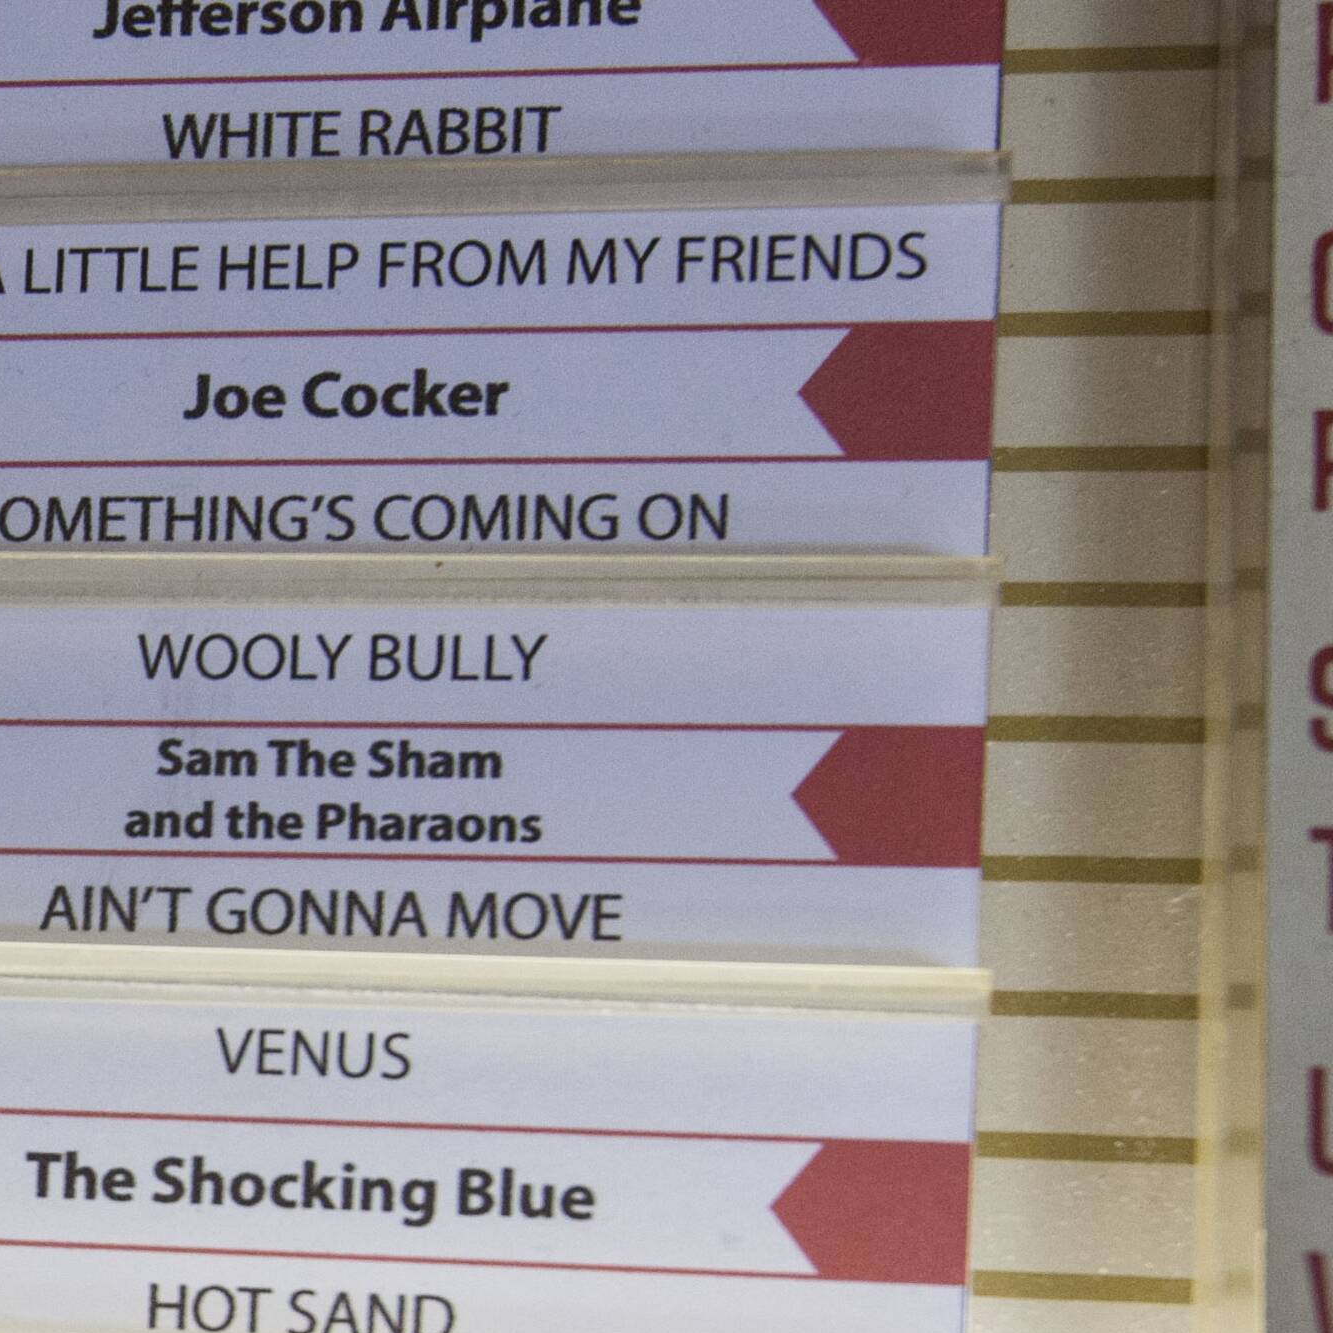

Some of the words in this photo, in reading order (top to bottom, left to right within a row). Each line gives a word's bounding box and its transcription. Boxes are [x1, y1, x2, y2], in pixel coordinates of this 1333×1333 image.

[93, 0, 363, 39] Jefferson
[381, 0, 641, 43] Airplane
[163, 111, 340, 160] WHITE
[359, 106, 561, 157] RABBIT
[24, 245, 199, 294] LITTLE
[218, 242, 360, 291] HELP
[379, 239, 546, 288] FROM
[567, 237, 660, 285] MY
[677, 231, 927, 283] FRIENDS
[183, 373, 286, 420] Joe
[302, 368, 509, 418] Cocker
[374, 493, 619, 542] COMING
[638, 493, 728, 541] ON
[138, 633, 352, 681] WOOLY
[369, 633, 547, 682] BULLY
[157, 738, 258, 777] Sam
[268, 738, 356, 778] The
[368, 739, 502, 779] Sham
[124, 803, 213, 840] and
[225, 804, 304, 841] the
[317, 805, 542, 844] Pharaons
[39, 885, 192, 934] AIN'T
[206, 887, 428, 938] GONNA
[447, 892, 622, 942] MOVE
[216, 1028, 411, 1081] VENUS
[26, 1151, 136, 1202] The
[153, 1155, 437, 1227] Shocking
[458, 1167, 595, 1221] Blue
[148, 1283, 272, 1333] HOT
